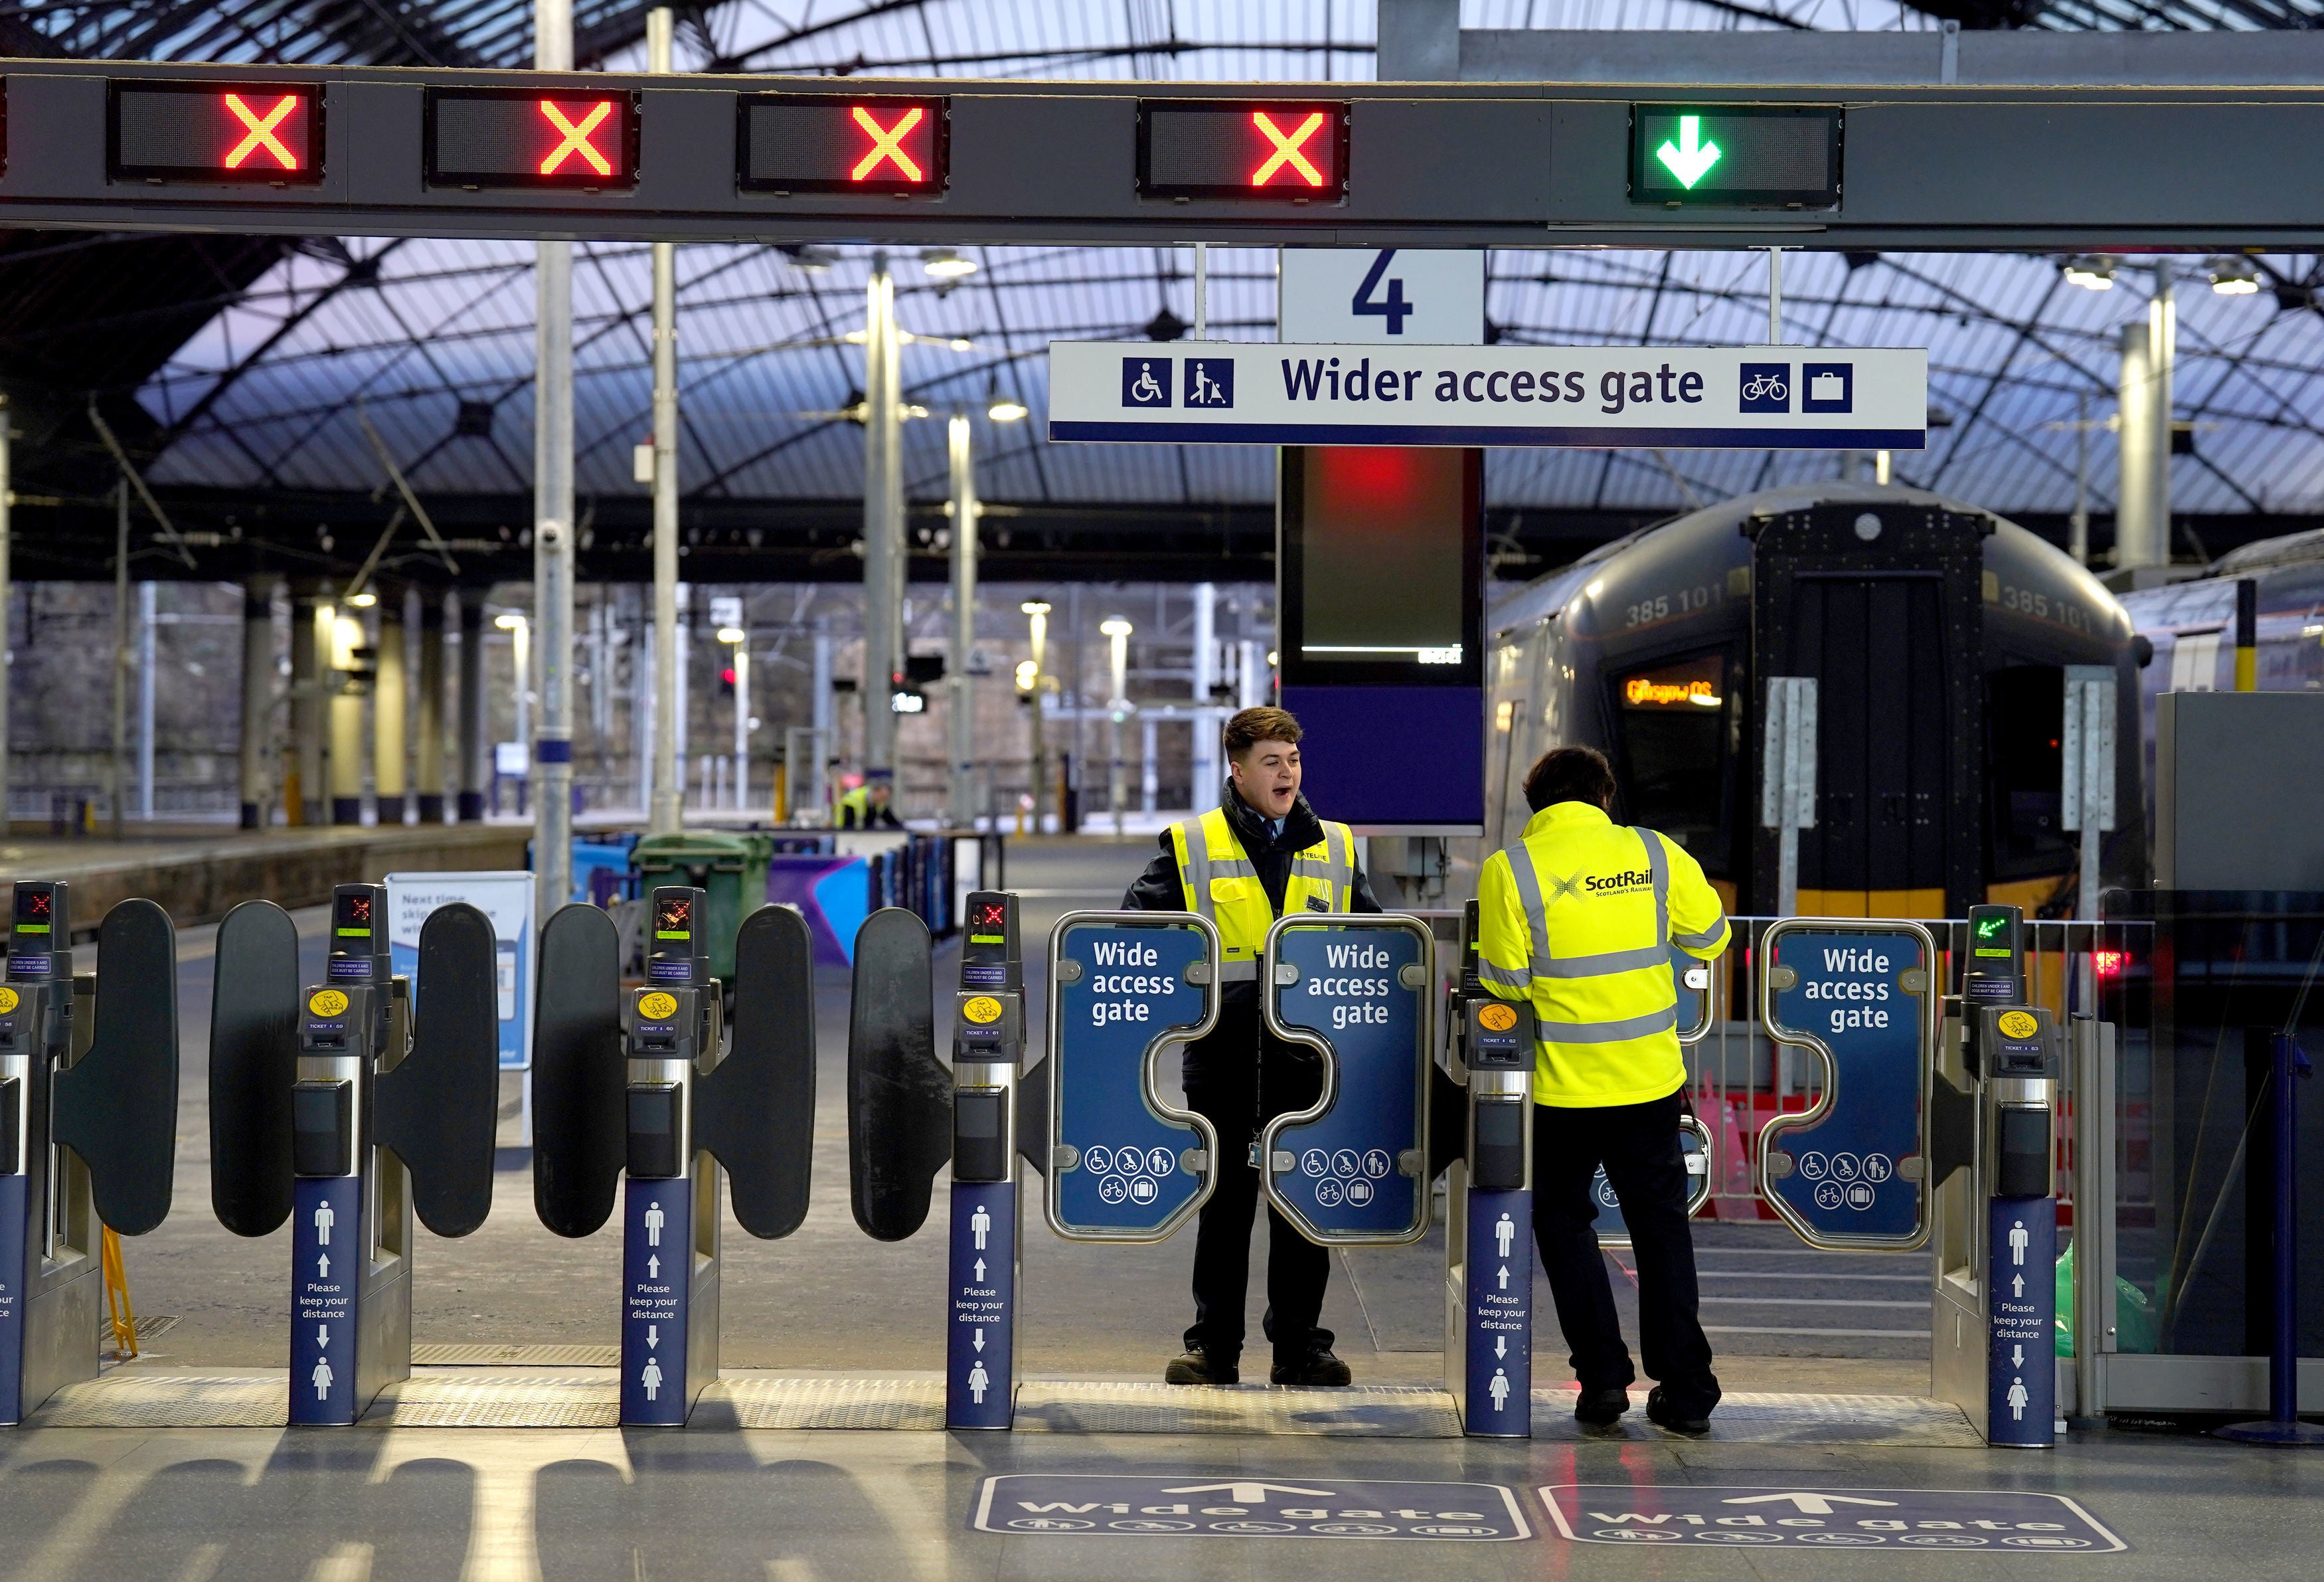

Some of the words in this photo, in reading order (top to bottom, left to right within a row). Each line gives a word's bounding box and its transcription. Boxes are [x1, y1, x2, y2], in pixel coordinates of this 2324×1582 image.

[1353, 249, 1413, 335] 4
[1281, 357, 1422, 402] Wider
[1434, 369, 1586, 403] access
[1600, 363, 1704, 414] gate
[1626, 596, 1669, 628] 385
[1679, 582, 1721, 611] 101
[2004, 586, 2048, 616] 385
[1585, 868, 1653, 891] ScotRail
[402, 895, 432, 904] Next
[1093, 942, 1157, 966] Wide
[1326, 944, 1390, 969] Wide
[1824, 948, 1889, 973] Wide
[1093, 973, 1175, 994] access
[1308, 976, 1389, 996] access
[1805, 980, 1888, 1001] access
[1092, 998, 1149, 1027] gate
[1332, 1001, 1388, 1029] gate
[1830, 1005, 1888, 1033] gate
[307, 1283, 341, 1292] Please
[637, 1284, 669, 1292] Please
[300, 1296, 323, 1306] keep
[325, 1298, 348, 1307] your
[630, 1297, 652, 1308] keep
[655, 1299, 677, 1308] your
[956, 1300, 979, 1310] keep
[981, 1302, 1003, 1311] your
[1487, 1294, 1519, 1304] Please
[2002, 1303, 2034, 1312] Please
[1479, 1307, 1501, 1318] keep
[1504, 1310, 1525, 1318] your
[1994, 1316, 2017, 1326] keep
[2020, 1318, 2042, 1327] your
[1481, 1320, 1522, 1330] distance
[1997, 1329, 2039, 1338] distance
[1017, 1502, 1250, 1516] Wide
[1280, 1508, 1486, 1522] gate
[1587, 1512, 1827, 1527] Wide
[1856, 1518, 2066, 1532] gate
